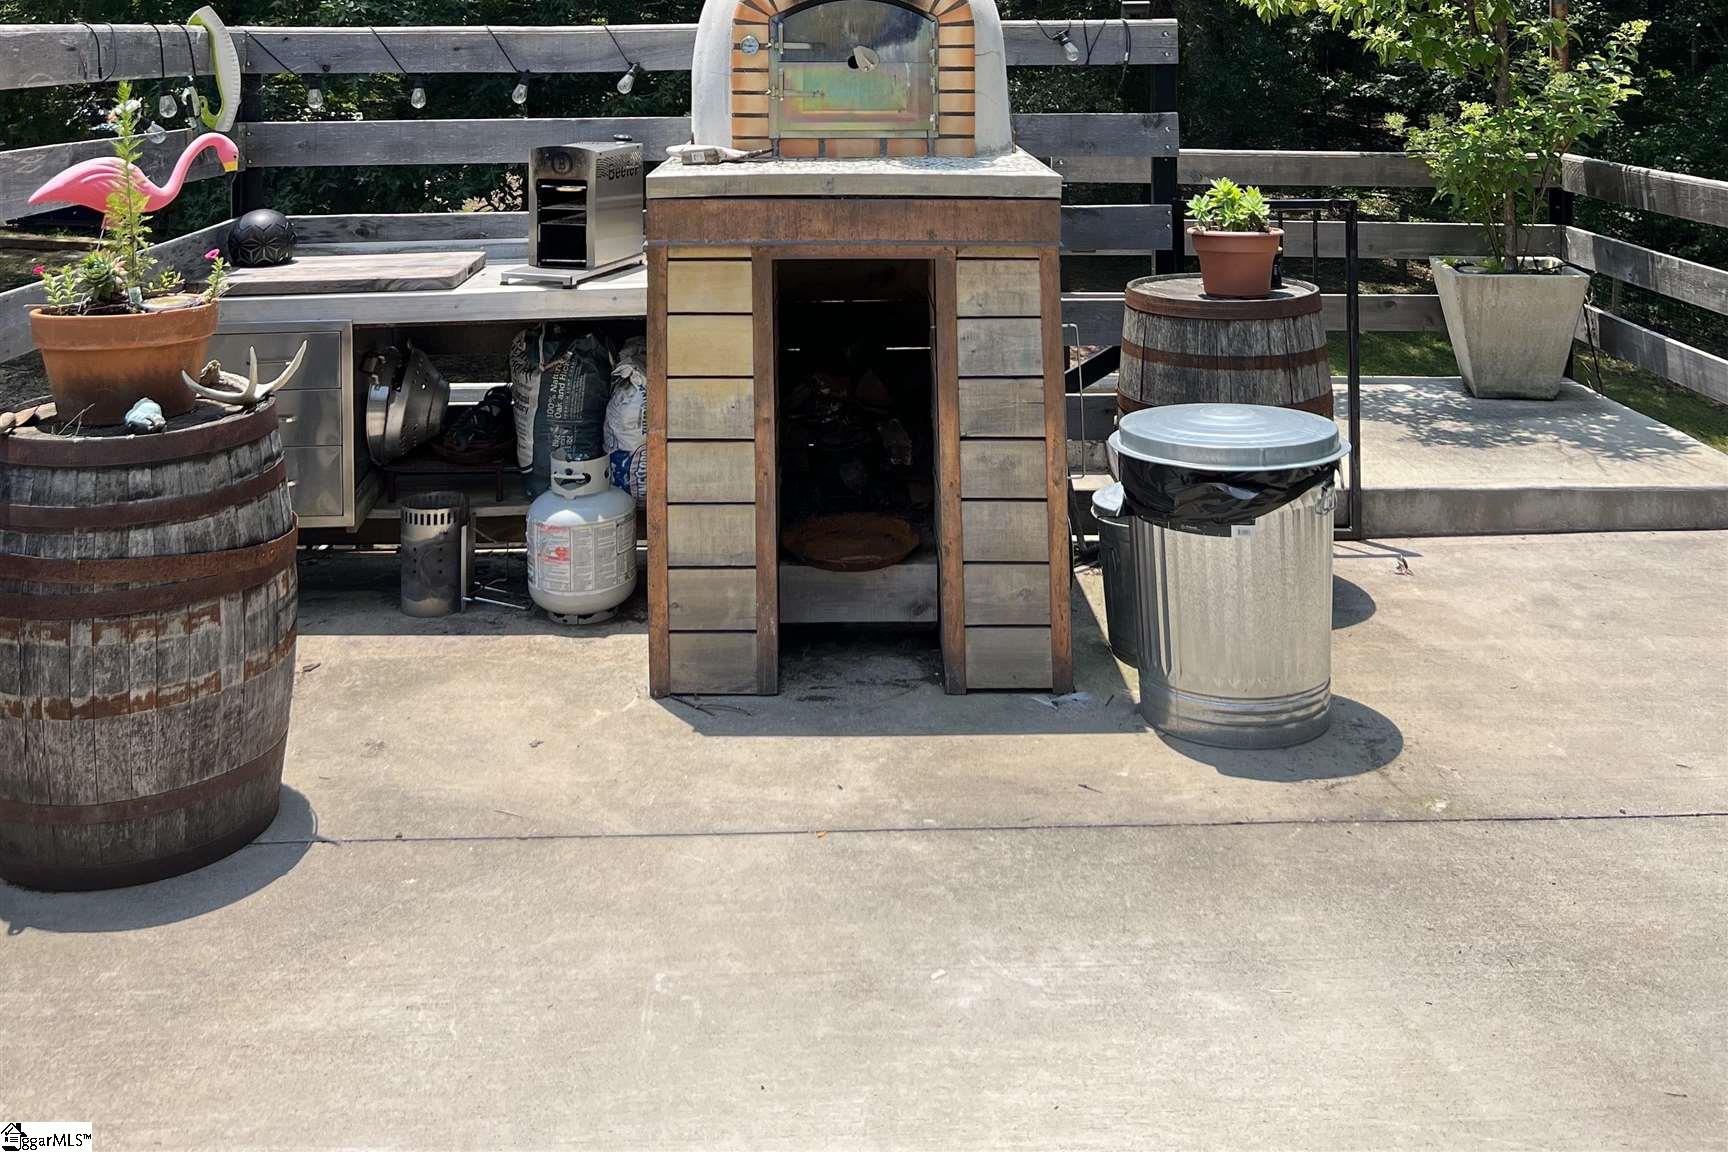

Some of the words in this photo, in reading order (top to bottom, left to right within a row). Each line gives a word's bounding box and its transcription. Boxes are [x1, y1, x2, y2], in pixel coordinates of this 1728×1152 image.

[557, 383, 566, 400] and
[546, 395, 556, 418] 100%
[554, 402, 563, 419] Oak
